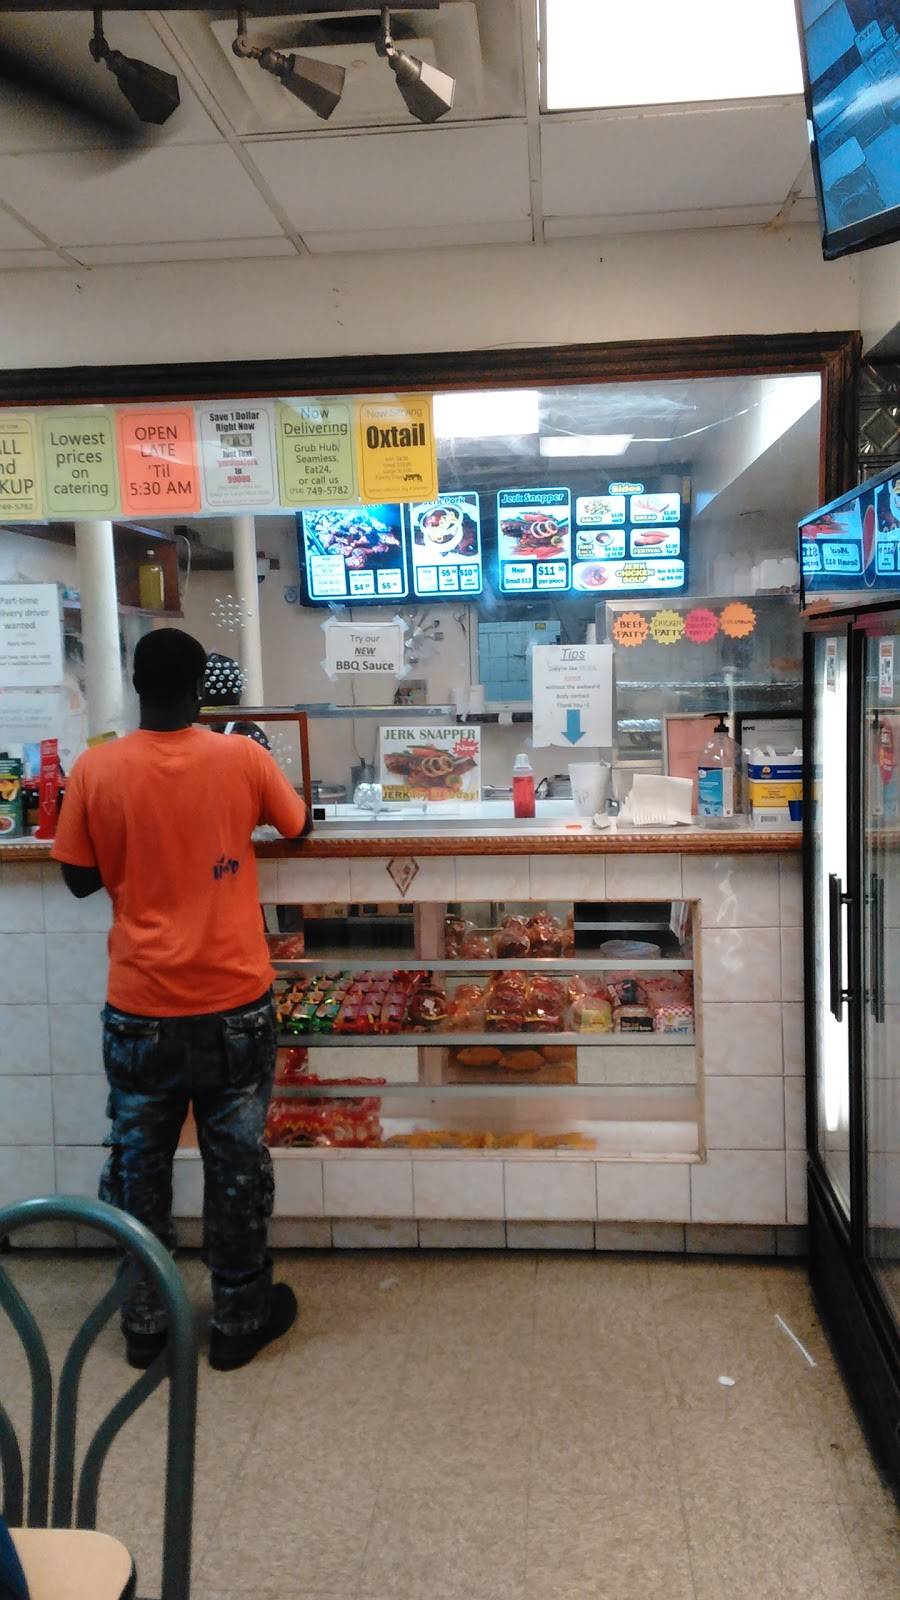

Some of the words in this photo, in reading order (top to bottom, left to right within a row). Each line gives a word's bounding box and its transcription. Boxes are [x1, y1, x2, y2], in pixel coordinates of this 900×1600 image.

[209, 412, 229, 422] Save
[230, 412, 234, 420] 1
[235, 410, 260, 420] Dollar
[301, 407, 330, 419] Now
[216, 422, 237, 432] Right
[238, 421, 255, 431] Now
[284, 422, 348, 436] Delivering
[51, 431, 105, 446] Lowest
[135, 425, 178, 441] OPEN
[366, 422, 426, 449] Oxtail
[141, 442, 176, 458] LATE
[294, 443, 317, 453] Grub
[56, 449, 103, 467] prices
[71, 468, 89, 479] on
[148, 464, 171, 478] 'Til
[311, 476, 327, 485] call
[54, 481, 109, 496] catering
[130, 482, 161, 496] 5:30
[166, 481, 192, 494] AM
[306, 485, 349, 496] 749-5782
[524, 492, 565, 504] Snapper
[538, 566, 556, 576] $11
[25, 608, 49, 617] driver
[4, 621, 36, 630] wanted
[619, 620, 642, 629] BEEF
[653, 619, 684, 627] CHICKEN
[350, 634, 363, 643] Try
[616, 630, 646, 639] PATTY
[654, 629, 683, 637] PATTY
[354, 647, 376, 655] NEW
[560, 648, 586, 660] Tips
[336, 660, 361, 671] BBQ
[363, 660, 395, 671] Sauce
[384, 729, 416, 740] JERK
[419, 728, 476, 740] SNAPPER
[384, 790, 410, 799] JERK
